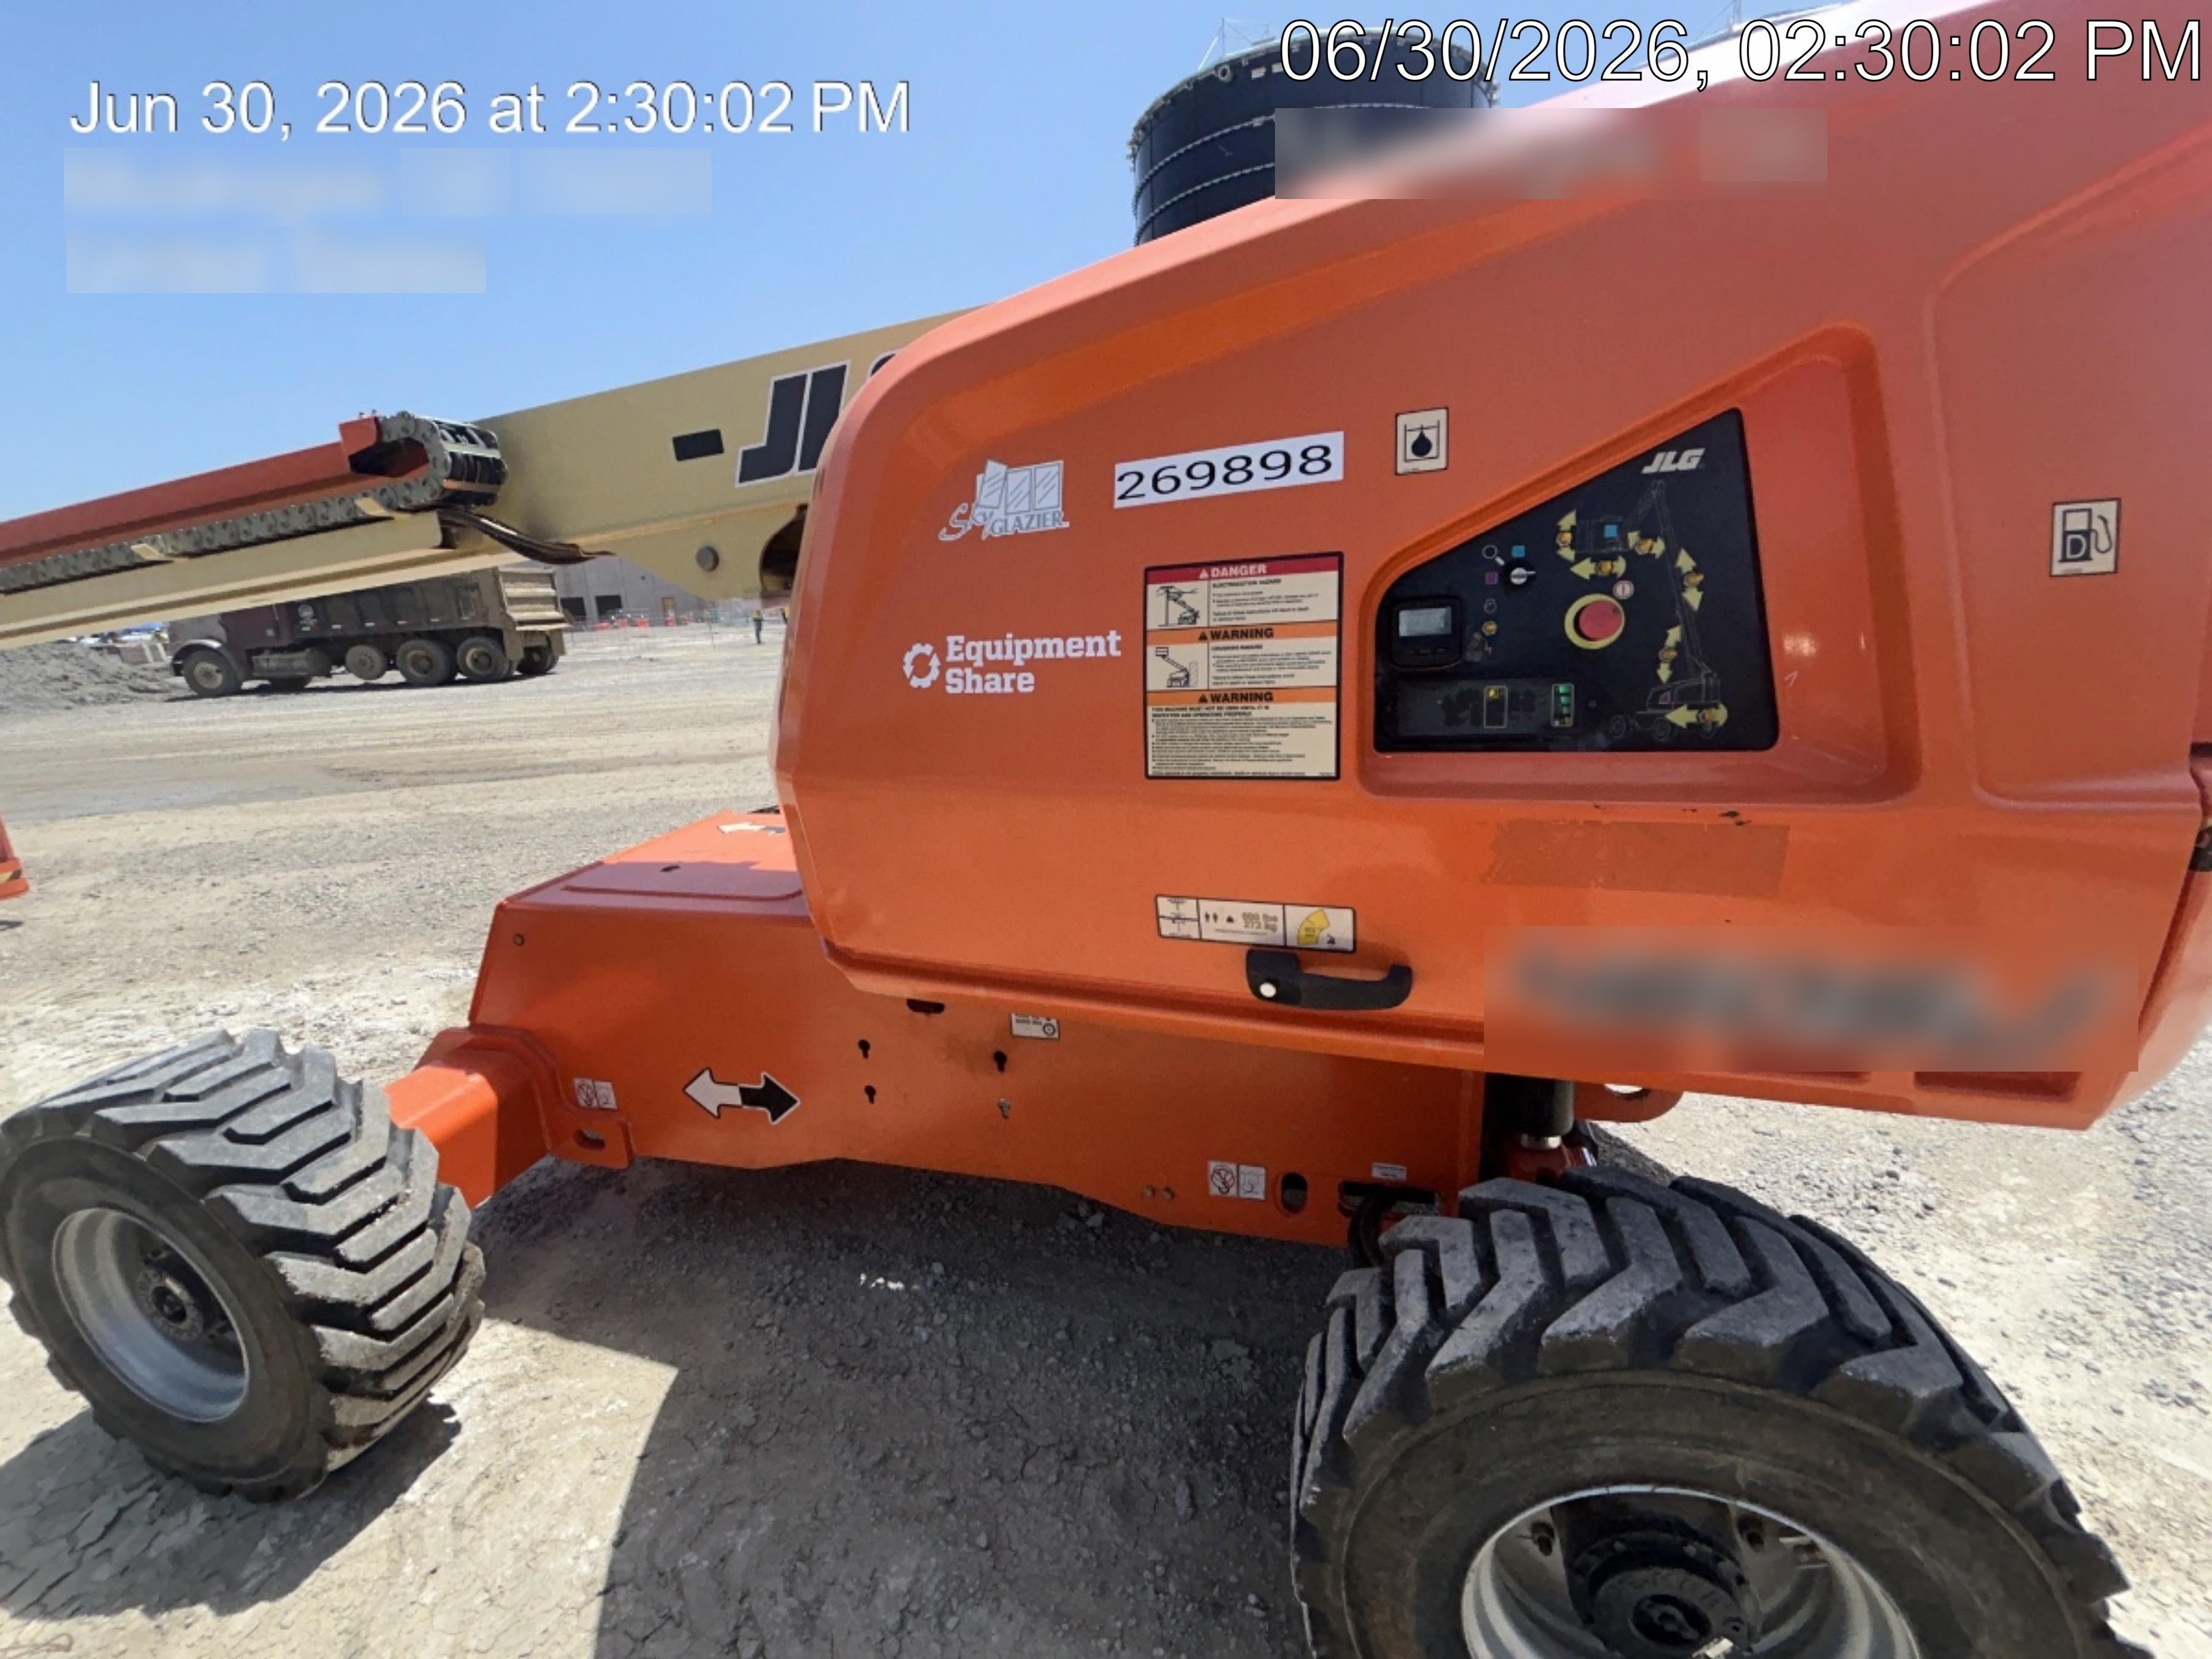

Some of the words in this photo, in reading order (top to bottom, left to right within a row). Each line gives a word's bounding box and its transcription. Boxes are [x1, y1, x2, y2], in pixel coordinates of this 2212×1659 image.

[1116, 444, 1333, 500] 269898
[1641, 447, 1706, 474] JLG
[991, 511, 1062, 535] GLAZIER
[1211, 563, 1267, 578] DANGER
[1211, 628, 1274, 640] WARNING
[946, 630, 1121, 667] Equipment
[944, 667, 1035, 694] Share
[1211, 692, 1274, 703] WARNING
